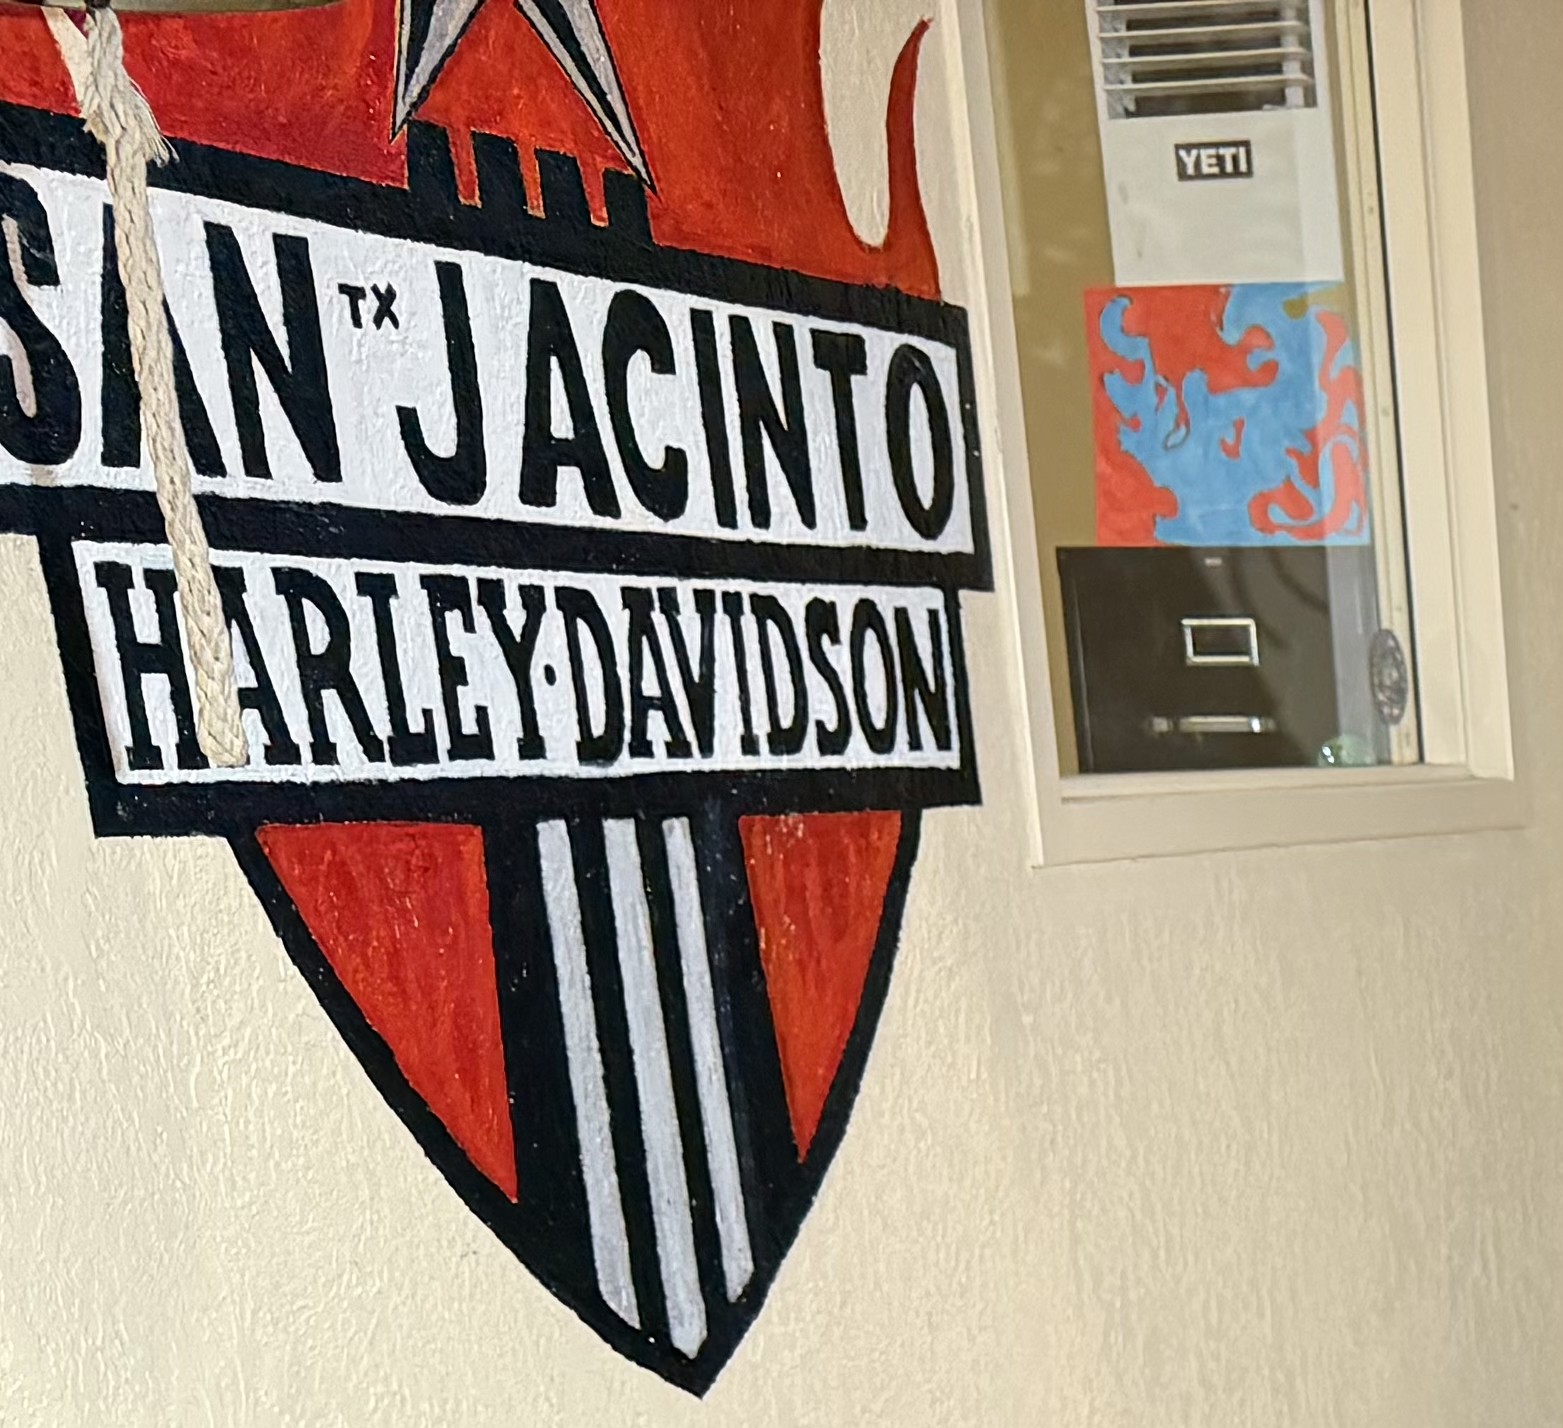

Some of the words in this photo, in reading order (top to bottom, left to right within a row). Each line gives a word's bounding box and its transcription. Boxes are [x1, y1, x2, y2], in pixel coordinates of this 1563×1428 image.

[1178, 146, 1248, 176] YETI
[0, 170, 343, 484] SAN
[338, 281, 401, 331] TX
[396, 259, 956, 542] JACINTO
